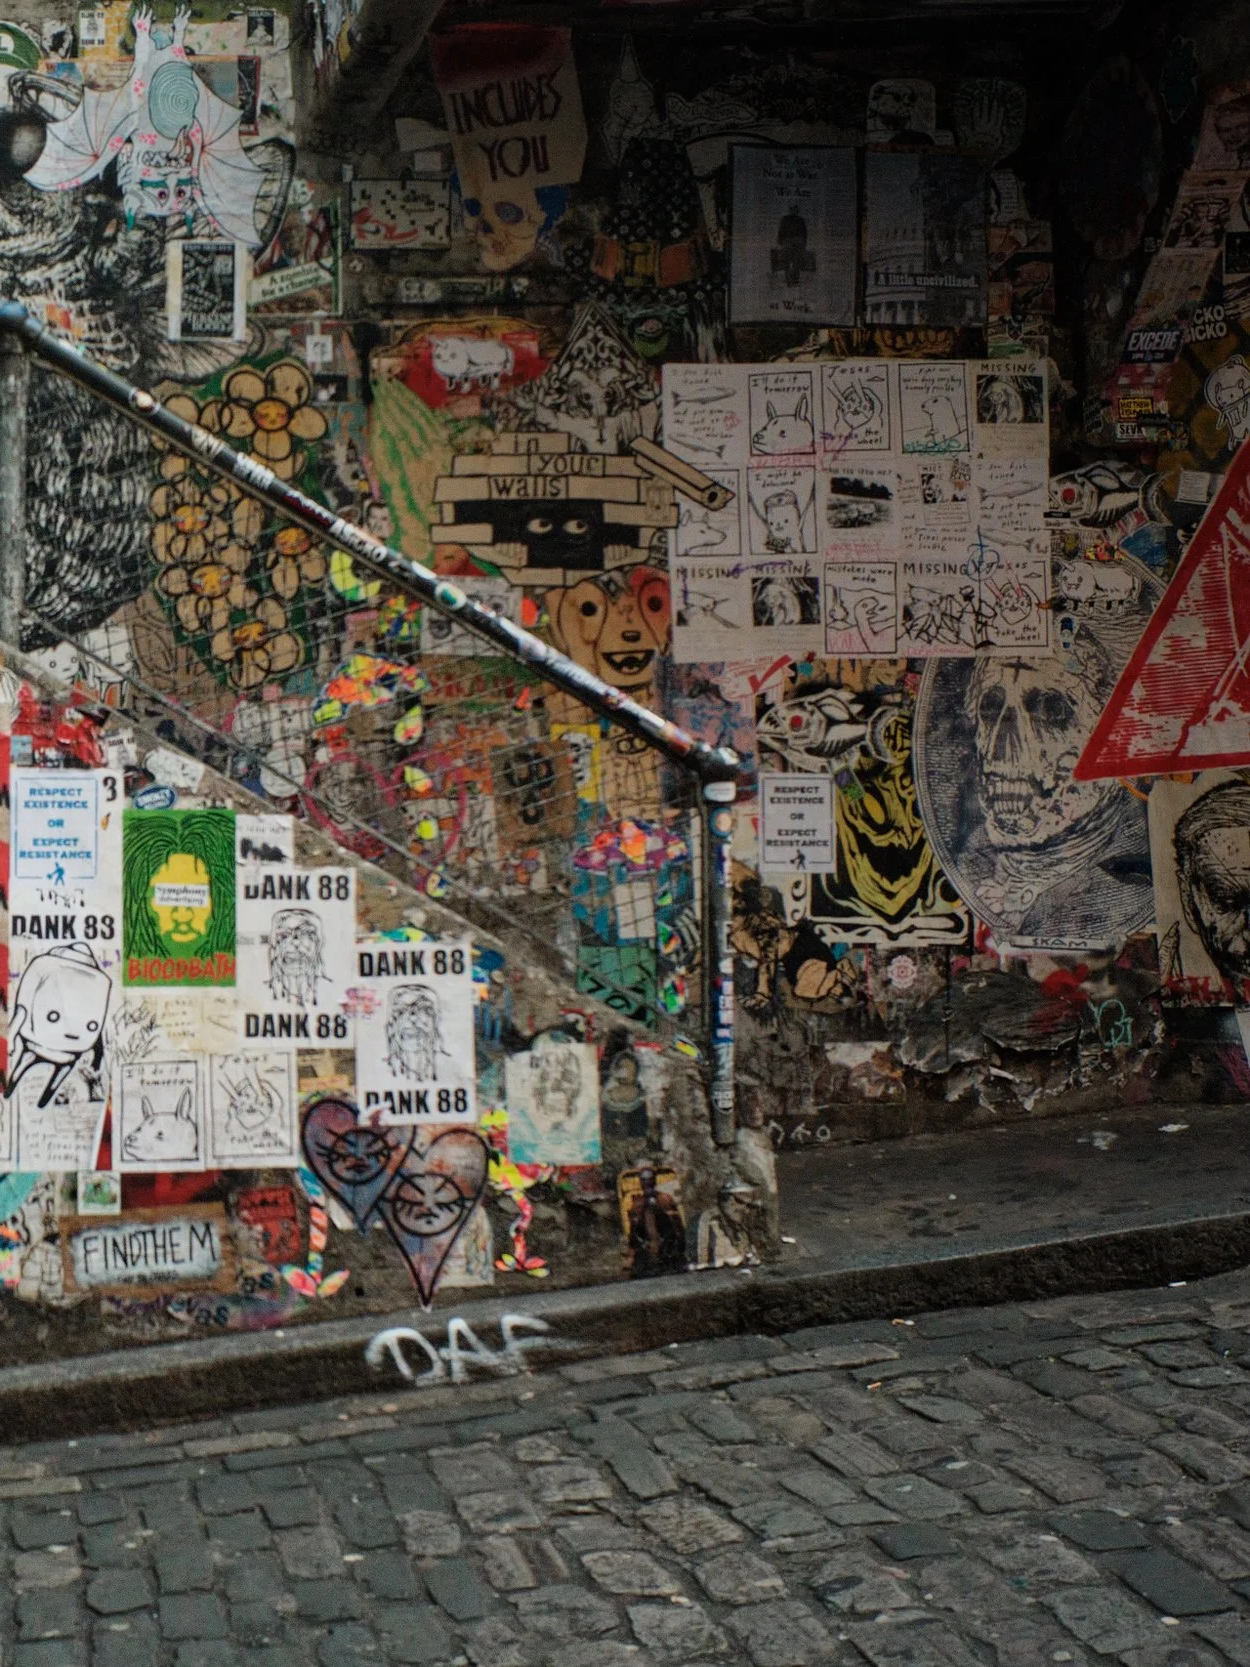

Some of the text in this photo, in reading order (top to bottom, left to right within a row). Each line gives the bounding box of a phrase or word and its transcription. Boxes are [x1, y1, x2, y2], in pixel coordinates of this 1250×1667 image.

[479, 135, 550, 183] YOU
[888, 274, 915, 286] little
[916, 274, 980, 289] uncivilized.
[980, 362, 1036, 373] MISSING
[513, 434, 541, 453] in
[536, 454, 600, 475] your
[492, 475, 563, 500] walls
[903, 562, 968, 576] MISSING
[29, 787, 83, 797] RESPECT
[774, 785, 819, 796] RESPECT
[23, 800, 88, 810] EXISTENCE
[769, 795, 825, 805] EXISTENCE
[789, 812, 805, 821] OR
[47, 818, 65, 828] OR
[777, 828, 817, 838] EXPECT
[32, 837, 79, 848] EXPECT
[765, 838, 830, 848] RESISTANCE
[19, 850, 92, 860] RESISTANCE
[244, 874, 350, 900] DANK 88
[11, 914, 77, 940] DANK
[358, 948, 466, 977] DANK 88
[244, 1013, 349, 1039] DANK 88
[365, 1087, 468, 1115] DANK 88
